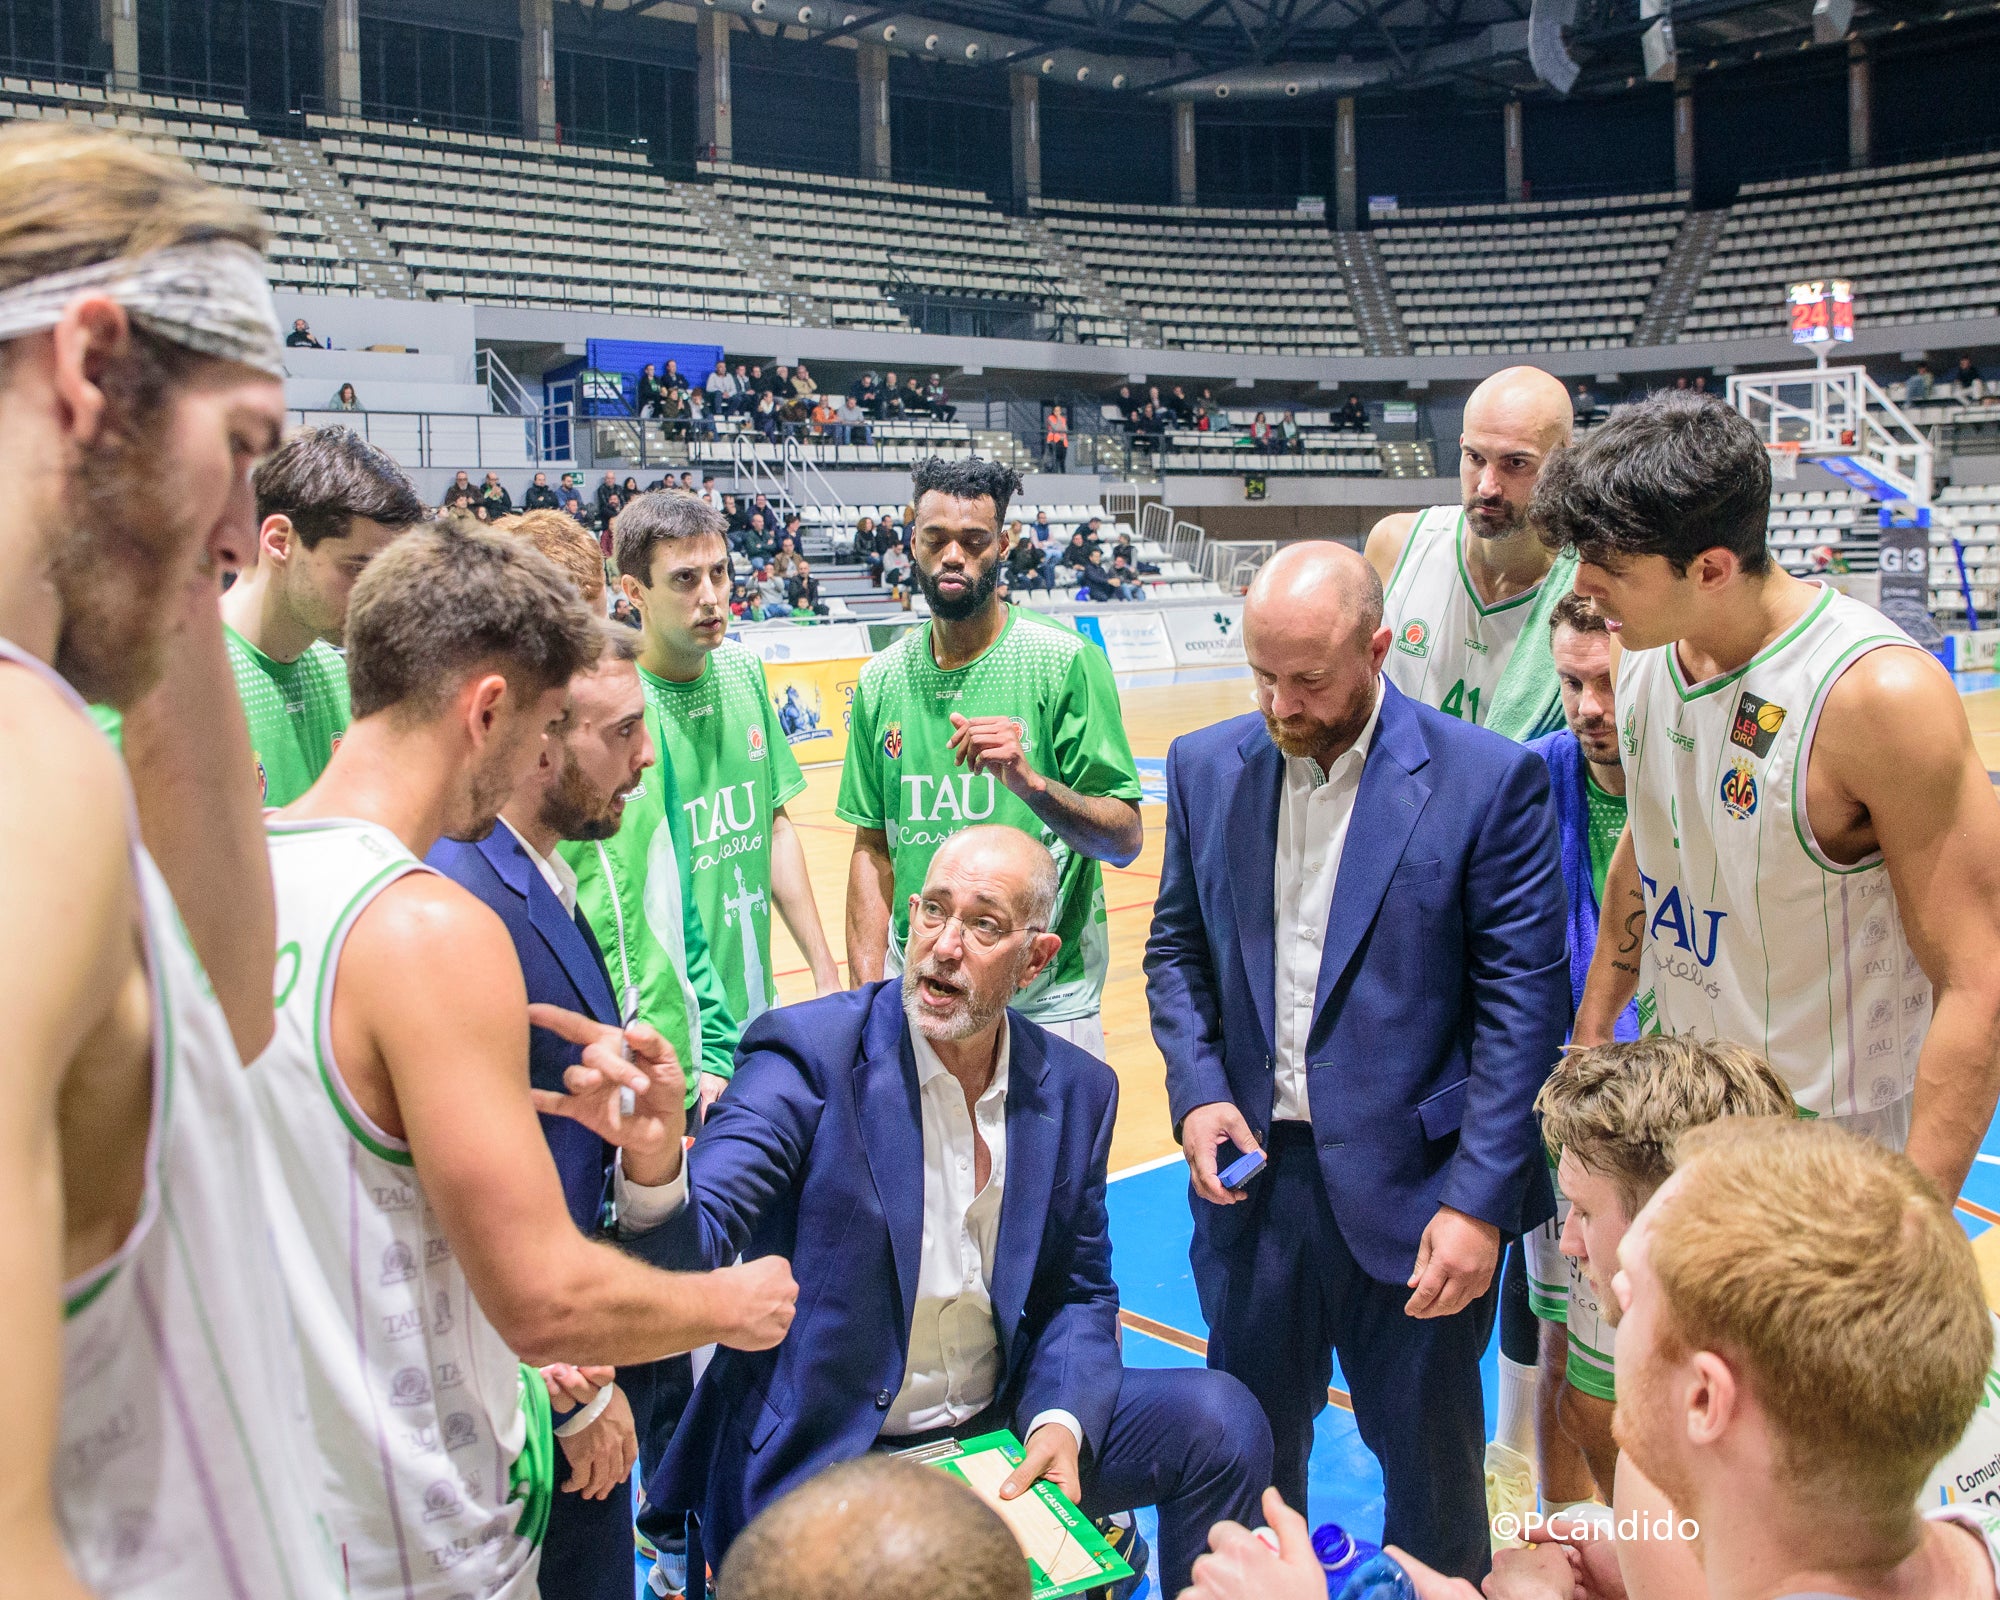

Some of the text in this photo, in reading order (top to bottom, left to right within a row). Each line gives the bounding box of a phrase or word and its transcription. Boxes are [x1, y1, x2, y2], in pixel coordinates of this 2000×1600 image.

[1791, 301, 1828, 329] 24
[1398, 640, 1425, 656] AMICS
[936, 690, 963, 699] SCORE
[1440, 678, 1480, 724] 41
[688, 704, 714, 718] SCORE
[1742, 699, 1756, 713] Liga
[1737, 717, 1758, 736] LEB
[1733, 730, 1754, 747] ORO
[901, 773, 995, 820] TAU
[683, 781, 755, 848] TAU
[1639, 871, 1728, 968] TAU
[1863, 958, 1893, 974] TAU
[1902, 991, 1928, 1010] TAU
[1867, 1038, 1894, 1056] TAU
[383, 1309, 422, 1334] TAU
[437, 1361, 463, 1382] TA
[1034, 1482, 1080, 1528] AU CASTELLÓ
